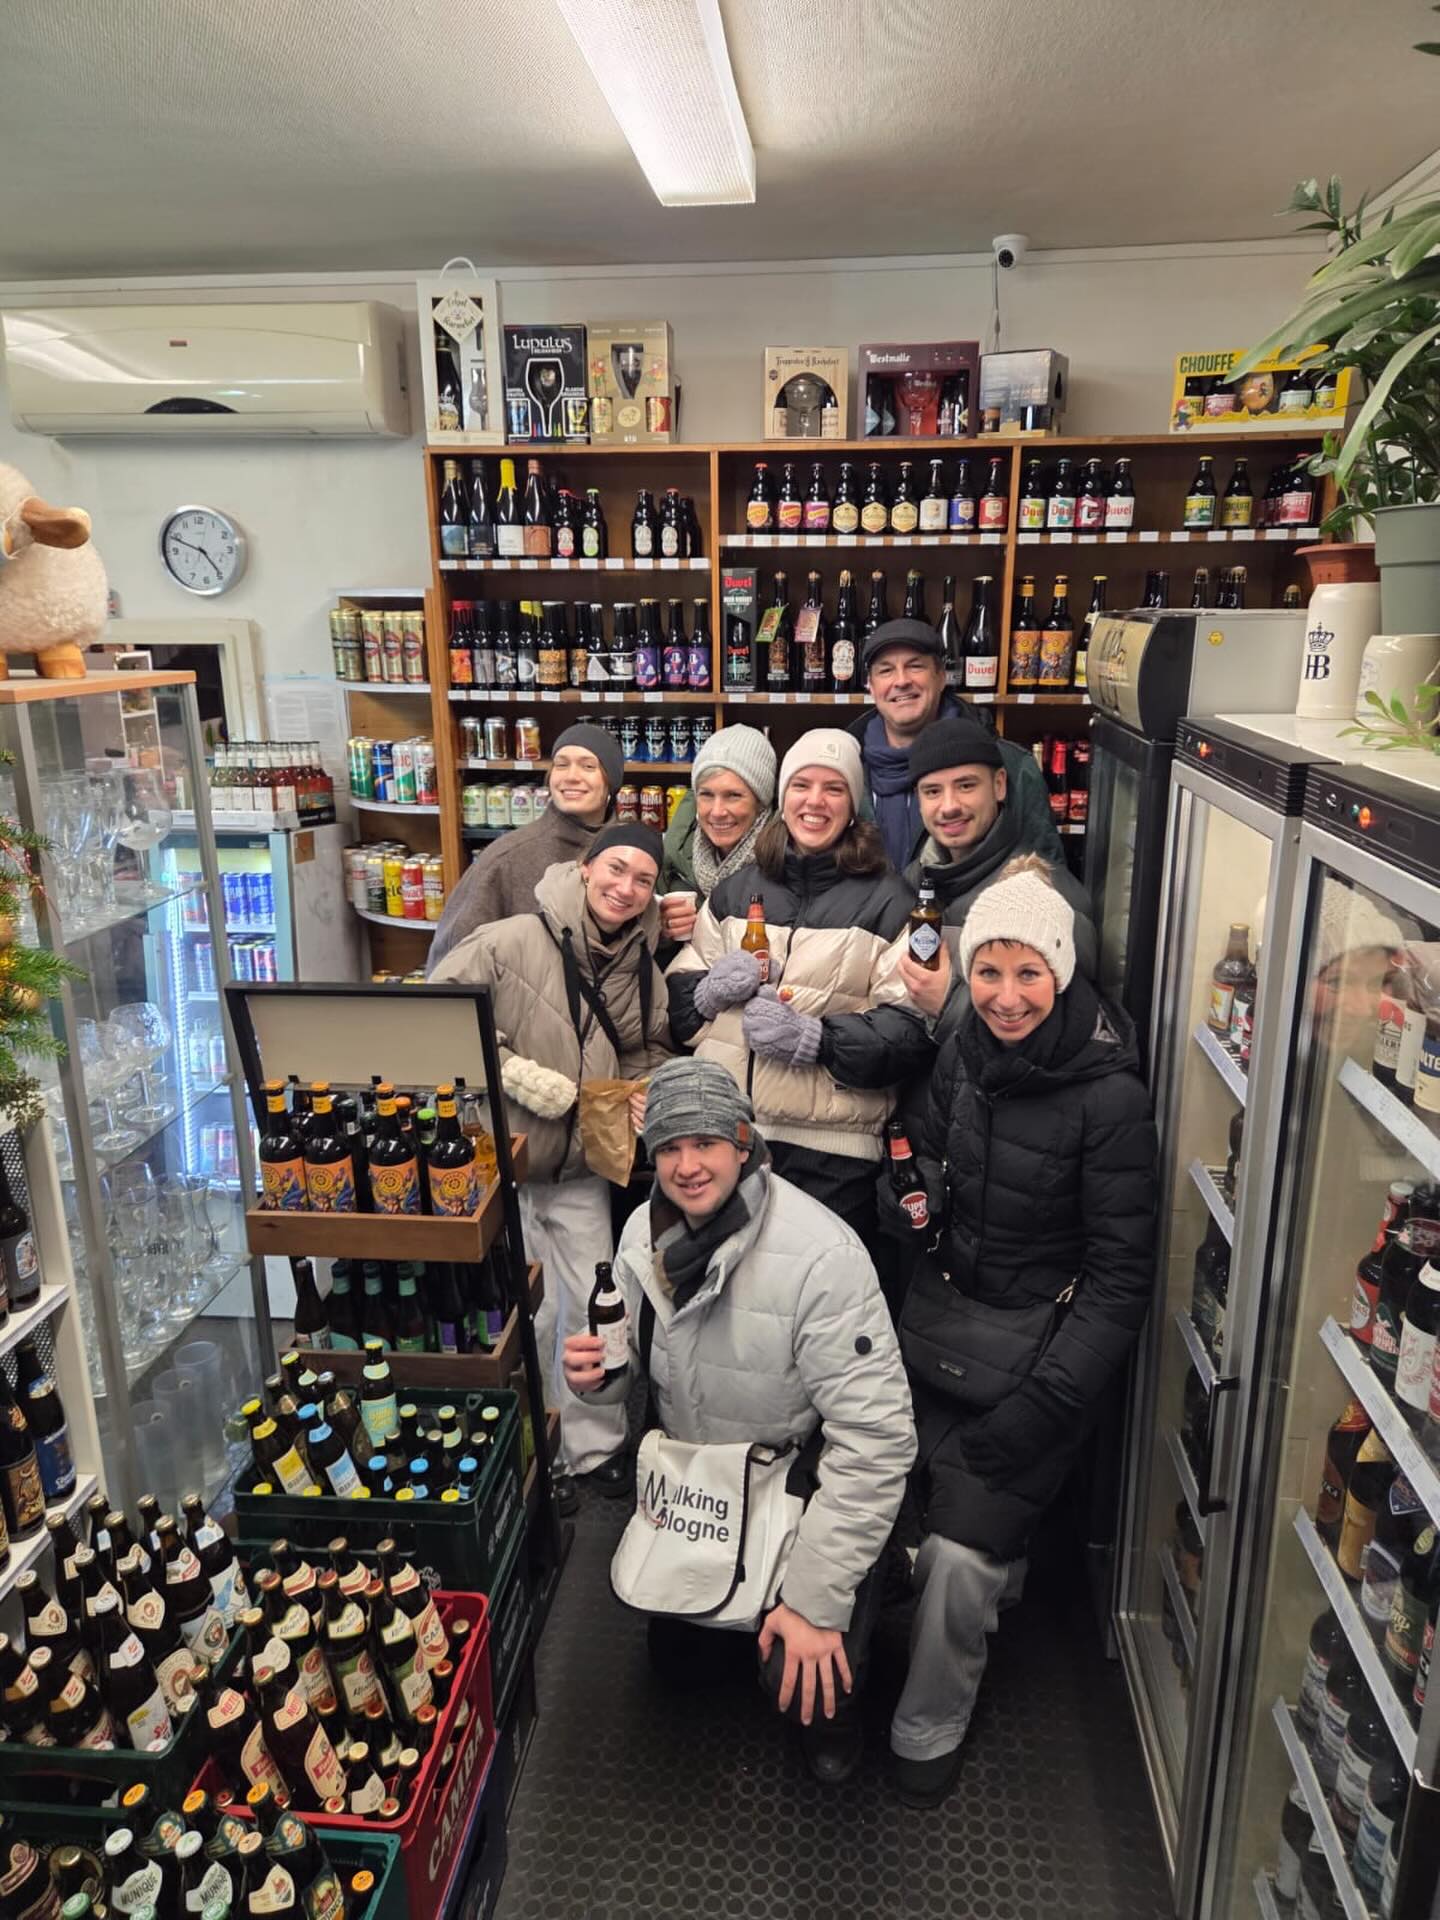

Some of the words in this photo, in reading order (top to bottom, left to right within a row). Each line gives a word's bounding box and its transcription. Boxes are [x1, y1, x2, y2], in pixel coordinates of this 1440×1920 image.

[1180, 353, 1235, 373] CHOUFFE
[193, 517, 204, 525] 12
[967, 664, 996, 674] Duvel
[1305, 655, 1330, 680] HB
[428, 1712, 485, 1884] CAMBA
